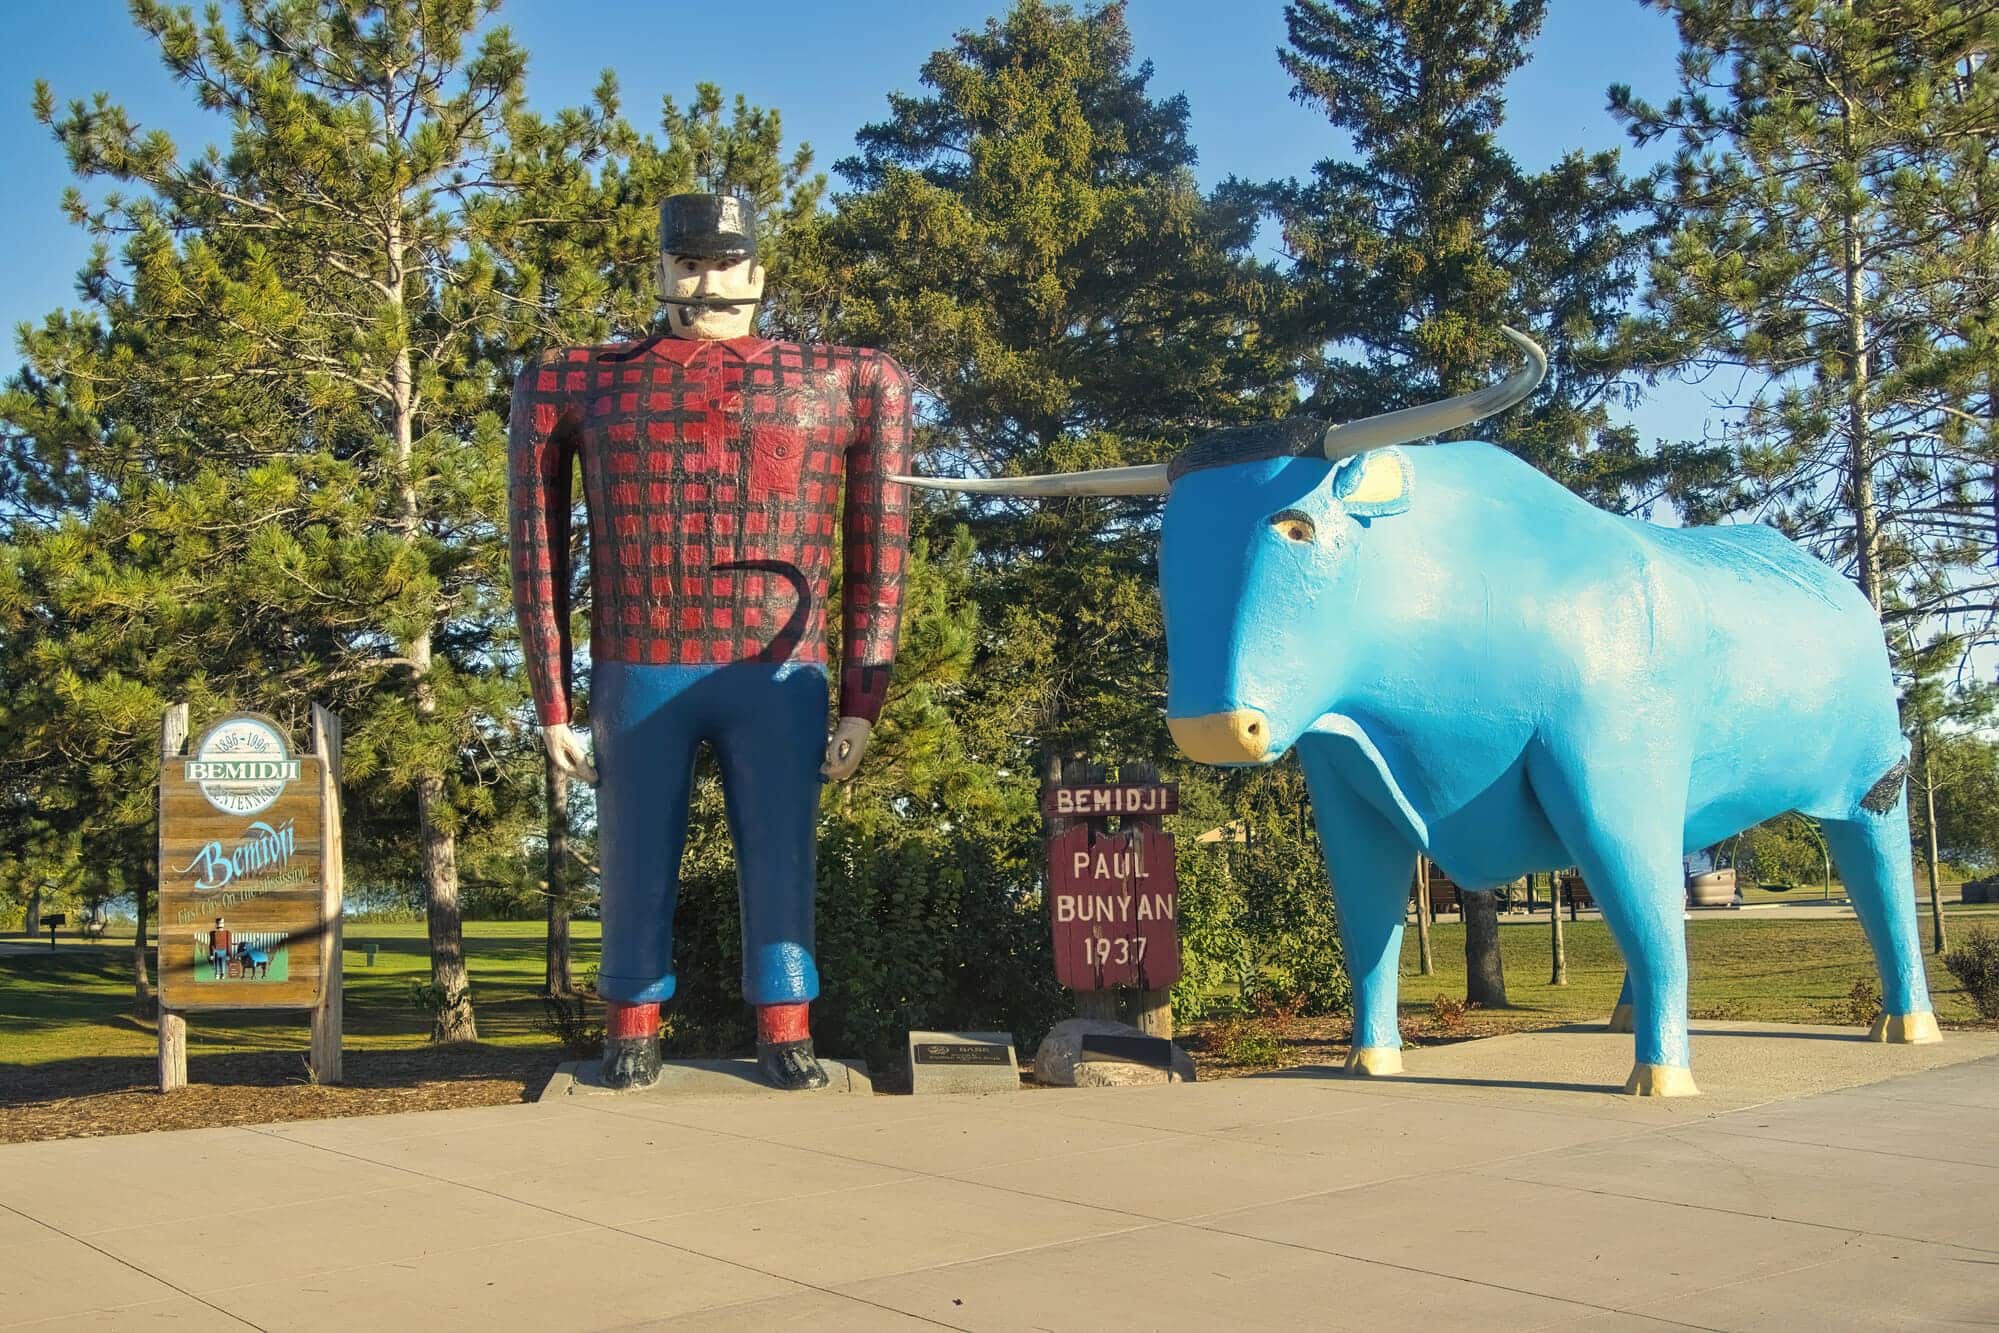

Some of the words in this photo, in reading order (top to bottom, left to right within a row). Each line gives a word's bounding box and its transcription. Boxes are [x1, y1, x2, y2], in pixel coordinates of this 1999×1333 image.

[188, 763, 298, 780] BEMIDJI
[1057, 788, 1167, 813] BEMIDJI
[172, 818, 297, 889] Bemidji
[1074, 852, 1149, 879] PAUL
[1057, 893, 1173, 922] BUNYAN
[1084, 936, 1147, 965] 1937
